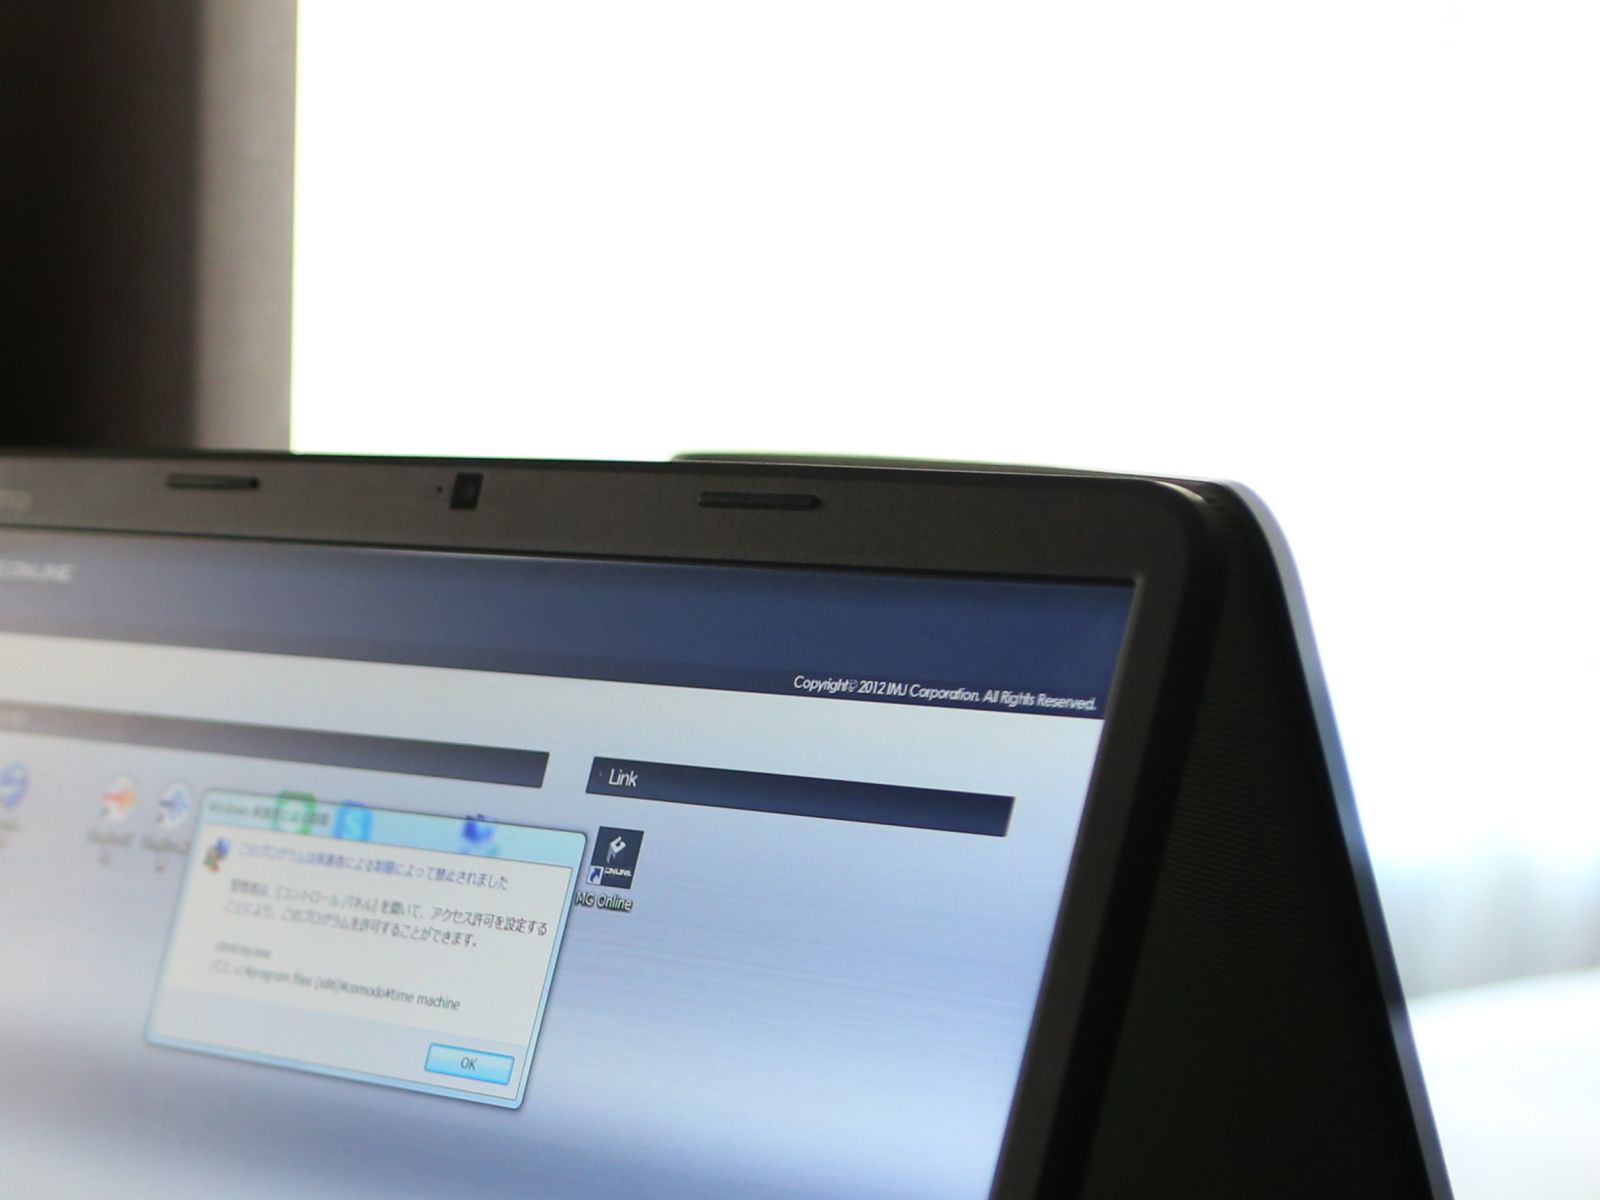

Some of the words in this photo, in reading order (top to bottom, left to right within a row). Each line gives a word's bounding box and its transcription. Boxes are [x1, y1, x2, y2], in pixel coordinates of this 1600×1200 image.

[858, 680, 886, 695] 2012
[886, 682, 908, 697] IMJ
[983, 689, 999, 703] All
[1000, 690, 1035, 707] Rights
[1037, 693, 1097, 711] Reserved.
[608, 768, 639, 787] Link
[596, 893, 633, 912] Online
[416, 994, 461, 1011] machine
[460, 1056, 477, 1071] OK
